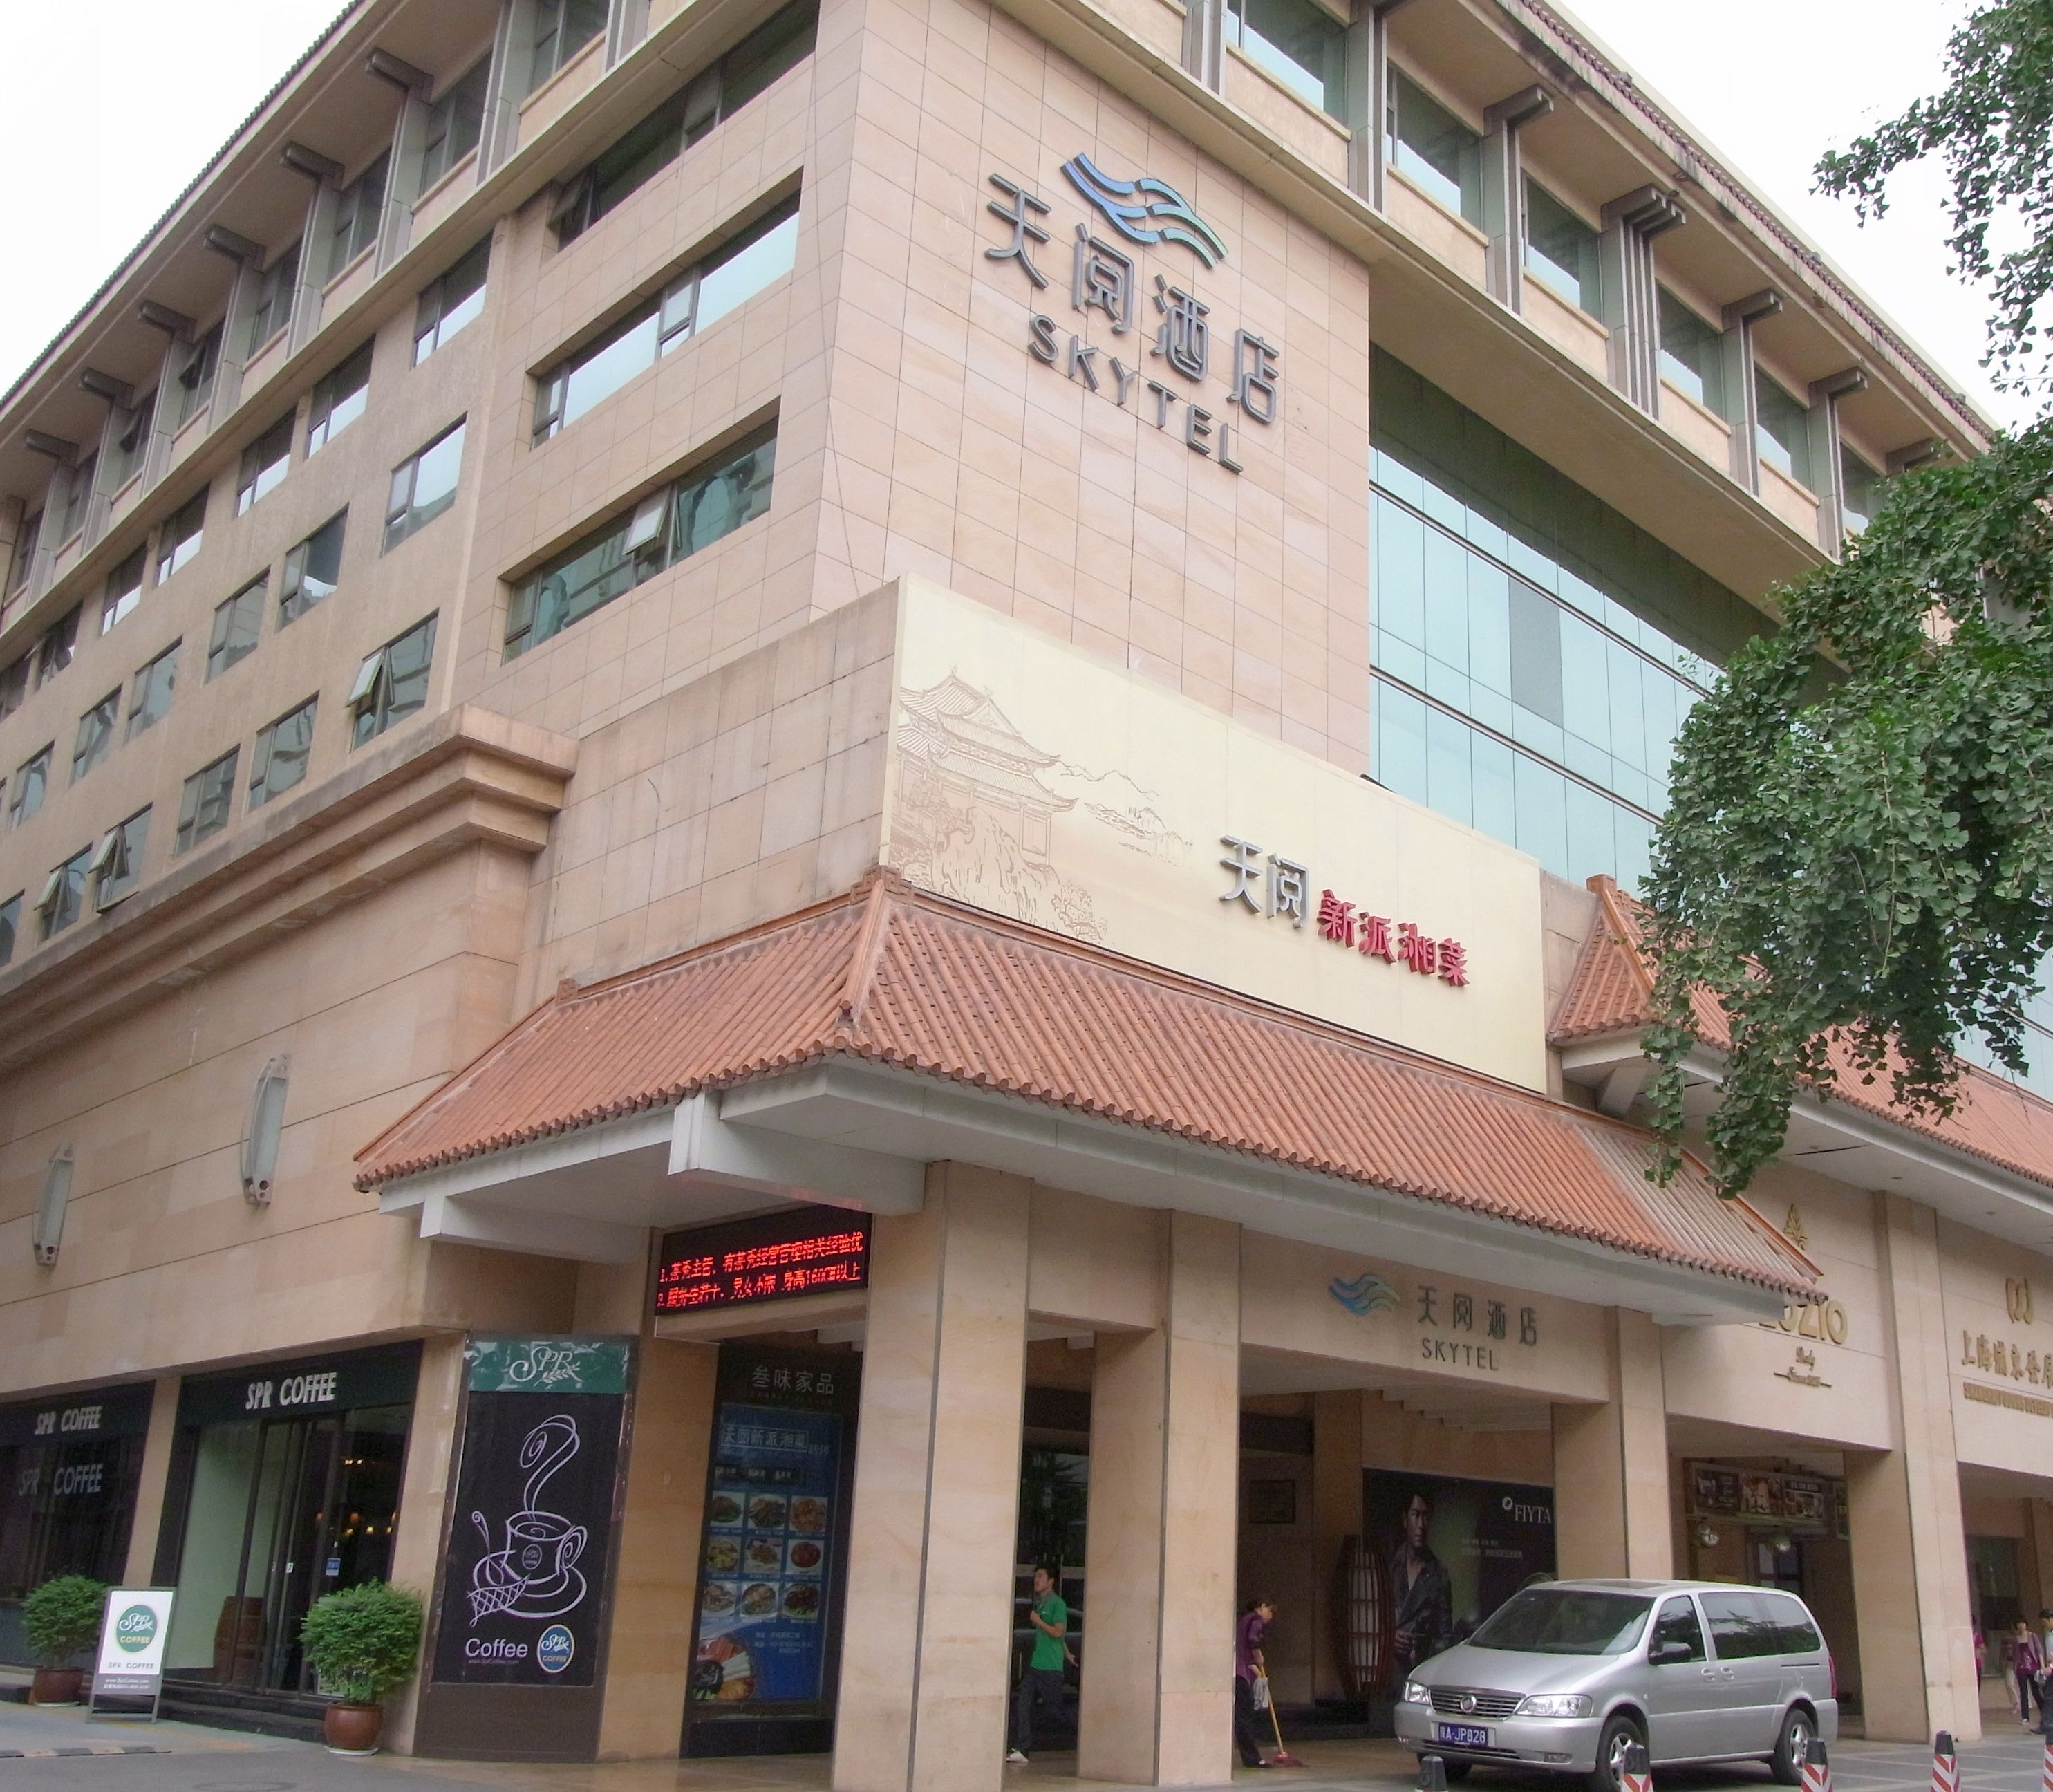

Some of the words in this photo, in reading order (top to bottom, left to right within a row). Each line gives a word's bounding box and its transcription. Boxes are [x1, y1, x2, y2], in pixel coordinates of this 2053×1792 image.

[984, 173, 1280, 424] 天阅酒店
[1028, 314, 1244, 474] SKYTEL
[1417, 1285, 1537, 1346] 天阅酒店
[509, 1345, 583, 1383] SPR
[1421, 1338, 1499, 1371] SKYTEL
[245, 1381, 274, 1410] SPR
[279, 1372, 338, 1406] COFFEE
[752, 1366, 834, 1395] 叁味家品
[35, 1411, 57, 1435] SPR
[61, 1405, 103, 1432] COFFEE
[19, 1468, 41, 1496] SPR
[54, 1463, 104, 1496] COFFEE
[1515, 1504, 1552, 1524] FIYTA
[120, 1636, 151, 1644] COFFEE
[465, 1638, 529, 1658] Coffee
